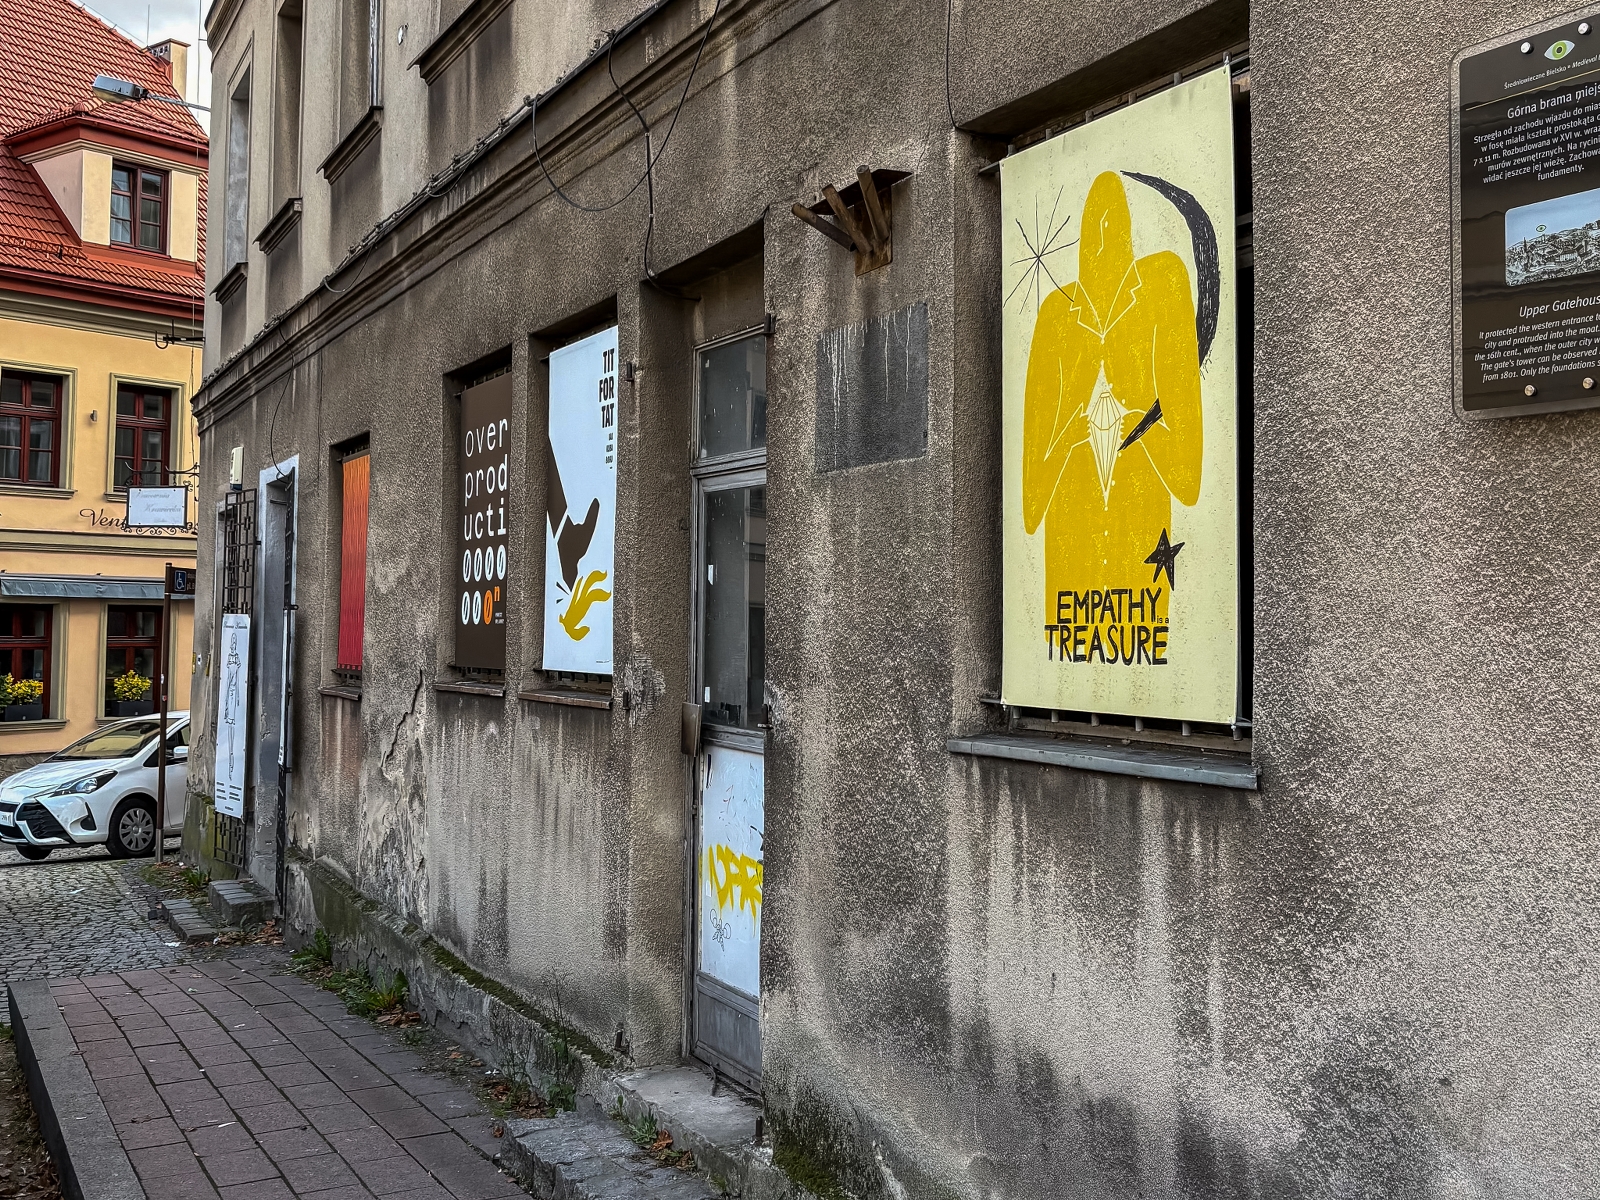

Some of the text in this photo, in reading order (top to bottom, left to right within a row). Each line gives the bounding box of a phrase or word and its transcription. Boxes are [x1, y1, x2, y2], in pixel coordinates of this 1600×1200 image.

[1546, 66, 1566, 76] Bielsko
[1572, 54, 1598, 68] Medieval
[1507, 104, 1536, 118] Górna
[1540, 93, 1572, 110] brama
[1474, 130, 1502, 143] Strzegła
[1503, 126, 1512, 135] od
[1514, 119, 1543, 132] zachodu
[1545, 110, 1571, 124] wjazdu
[1573, 107, 1582, 115] do
[1489, 141, 1504, 150] fosę
[1506, 135, 1524, 145] miała
[1554, 116, 1594, 134] prostokąta
[1488, 160, 1511, 171] murów
[1568, 143, 1577, 151] Na
[1502, 139, 1550, 157] Rozbudowana
[1560, 132, 1572, 142] XVI
[1483, 172, 1503, 183] widać
[1505, 166, 1530, 180] jeszcze
[1532, 162, 1541, 173] jej
[1538, 164, 1584, 180] fundamenty.
[1520, 295, 1600, 318] Upper Gatehous
[1485, 326, 1518, 340] protected
[1519, 324, 1530, 333] the
[1532, 320, 1560, 331] western
[1562, 315, 1594, 326] entrance
[1485, 325, 1600, 349] city and protruded into the moat.
[602, 348, 614, 374] TIT
[1474, 353, 1486, 361] the
[1487, 350, 1501, 359] 16th
[1524, 345, 1542, 354] when
[1545, 343, 1556, 351] the
[1558, 340, 1577, 349] outer
[1579, 338, 1592, 346] city
[1481, 363, 1492, 371] The
[1494, 360, 1514, 371] gate's
[1517, 358, 1536, 366] tower
[1552, 353, 1561, 361] be
[1563, 347, 1598, 360] observed
[1482, 373, 1498, 383] from
[1501, 371, 1518, 379] 1801.
[1521, 367, 1537, 376] Only
[1538, 366, 1550, 374] the
[1551, 360, 1595, 374] foundations
[599, 376, 614, 402] FOR
[601, 403, 614, 428] TAT
[466, 418, 508, 457] over
[464, 454, 507, 507] prod
[464, 497, 507, 541] ucti
[1056, 587, 1162, 624] EMPATHY
[1044, 625, 1169, 666] TREASURE
